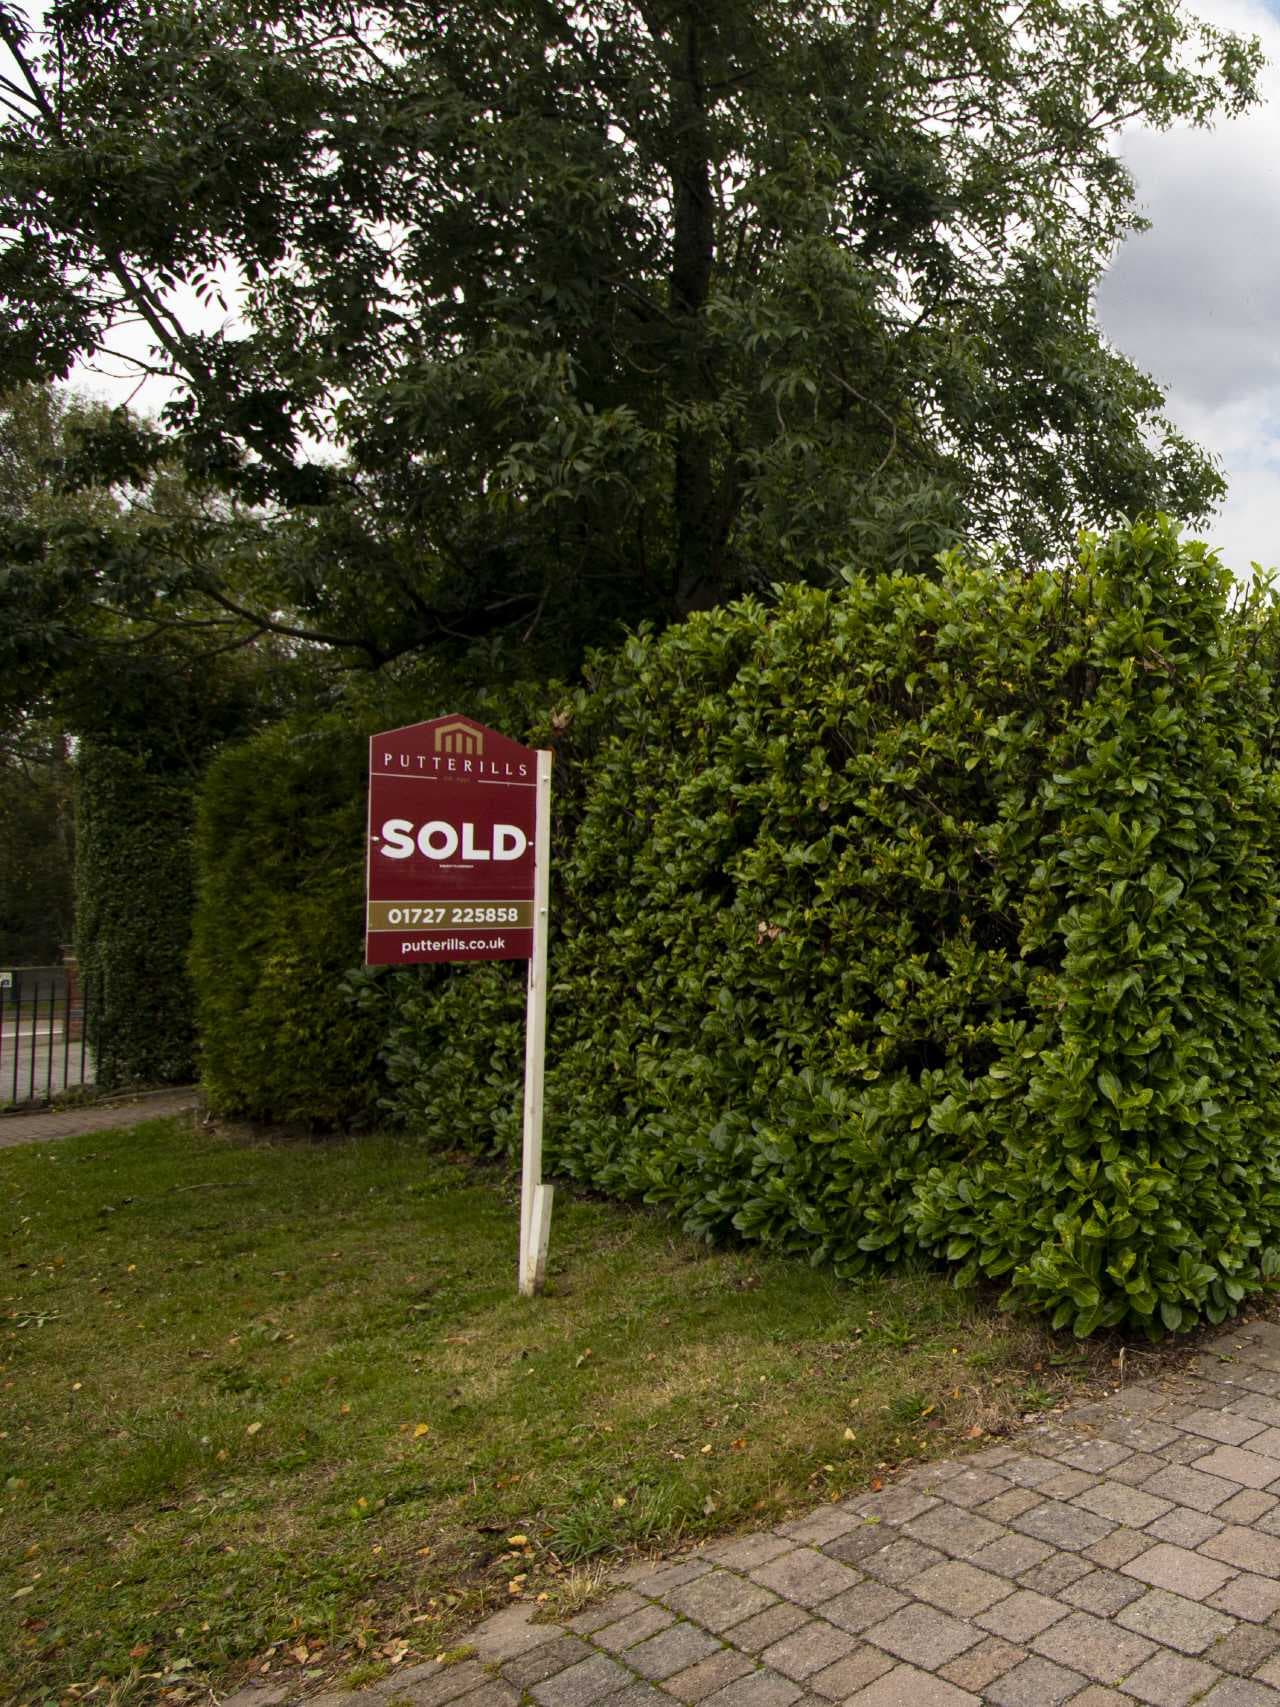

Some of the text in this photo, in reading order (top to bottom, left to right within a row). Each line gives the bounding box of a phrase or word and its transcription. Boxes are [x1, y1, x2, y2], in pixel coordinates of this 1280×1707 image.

[384, 753, 528, 776] PUTTERILLS
[380, 818, 528, 861] SOLD
[388, 907, 519, 924] 01727 225858
[401, 936, 506, 954] putterills.co.uk
